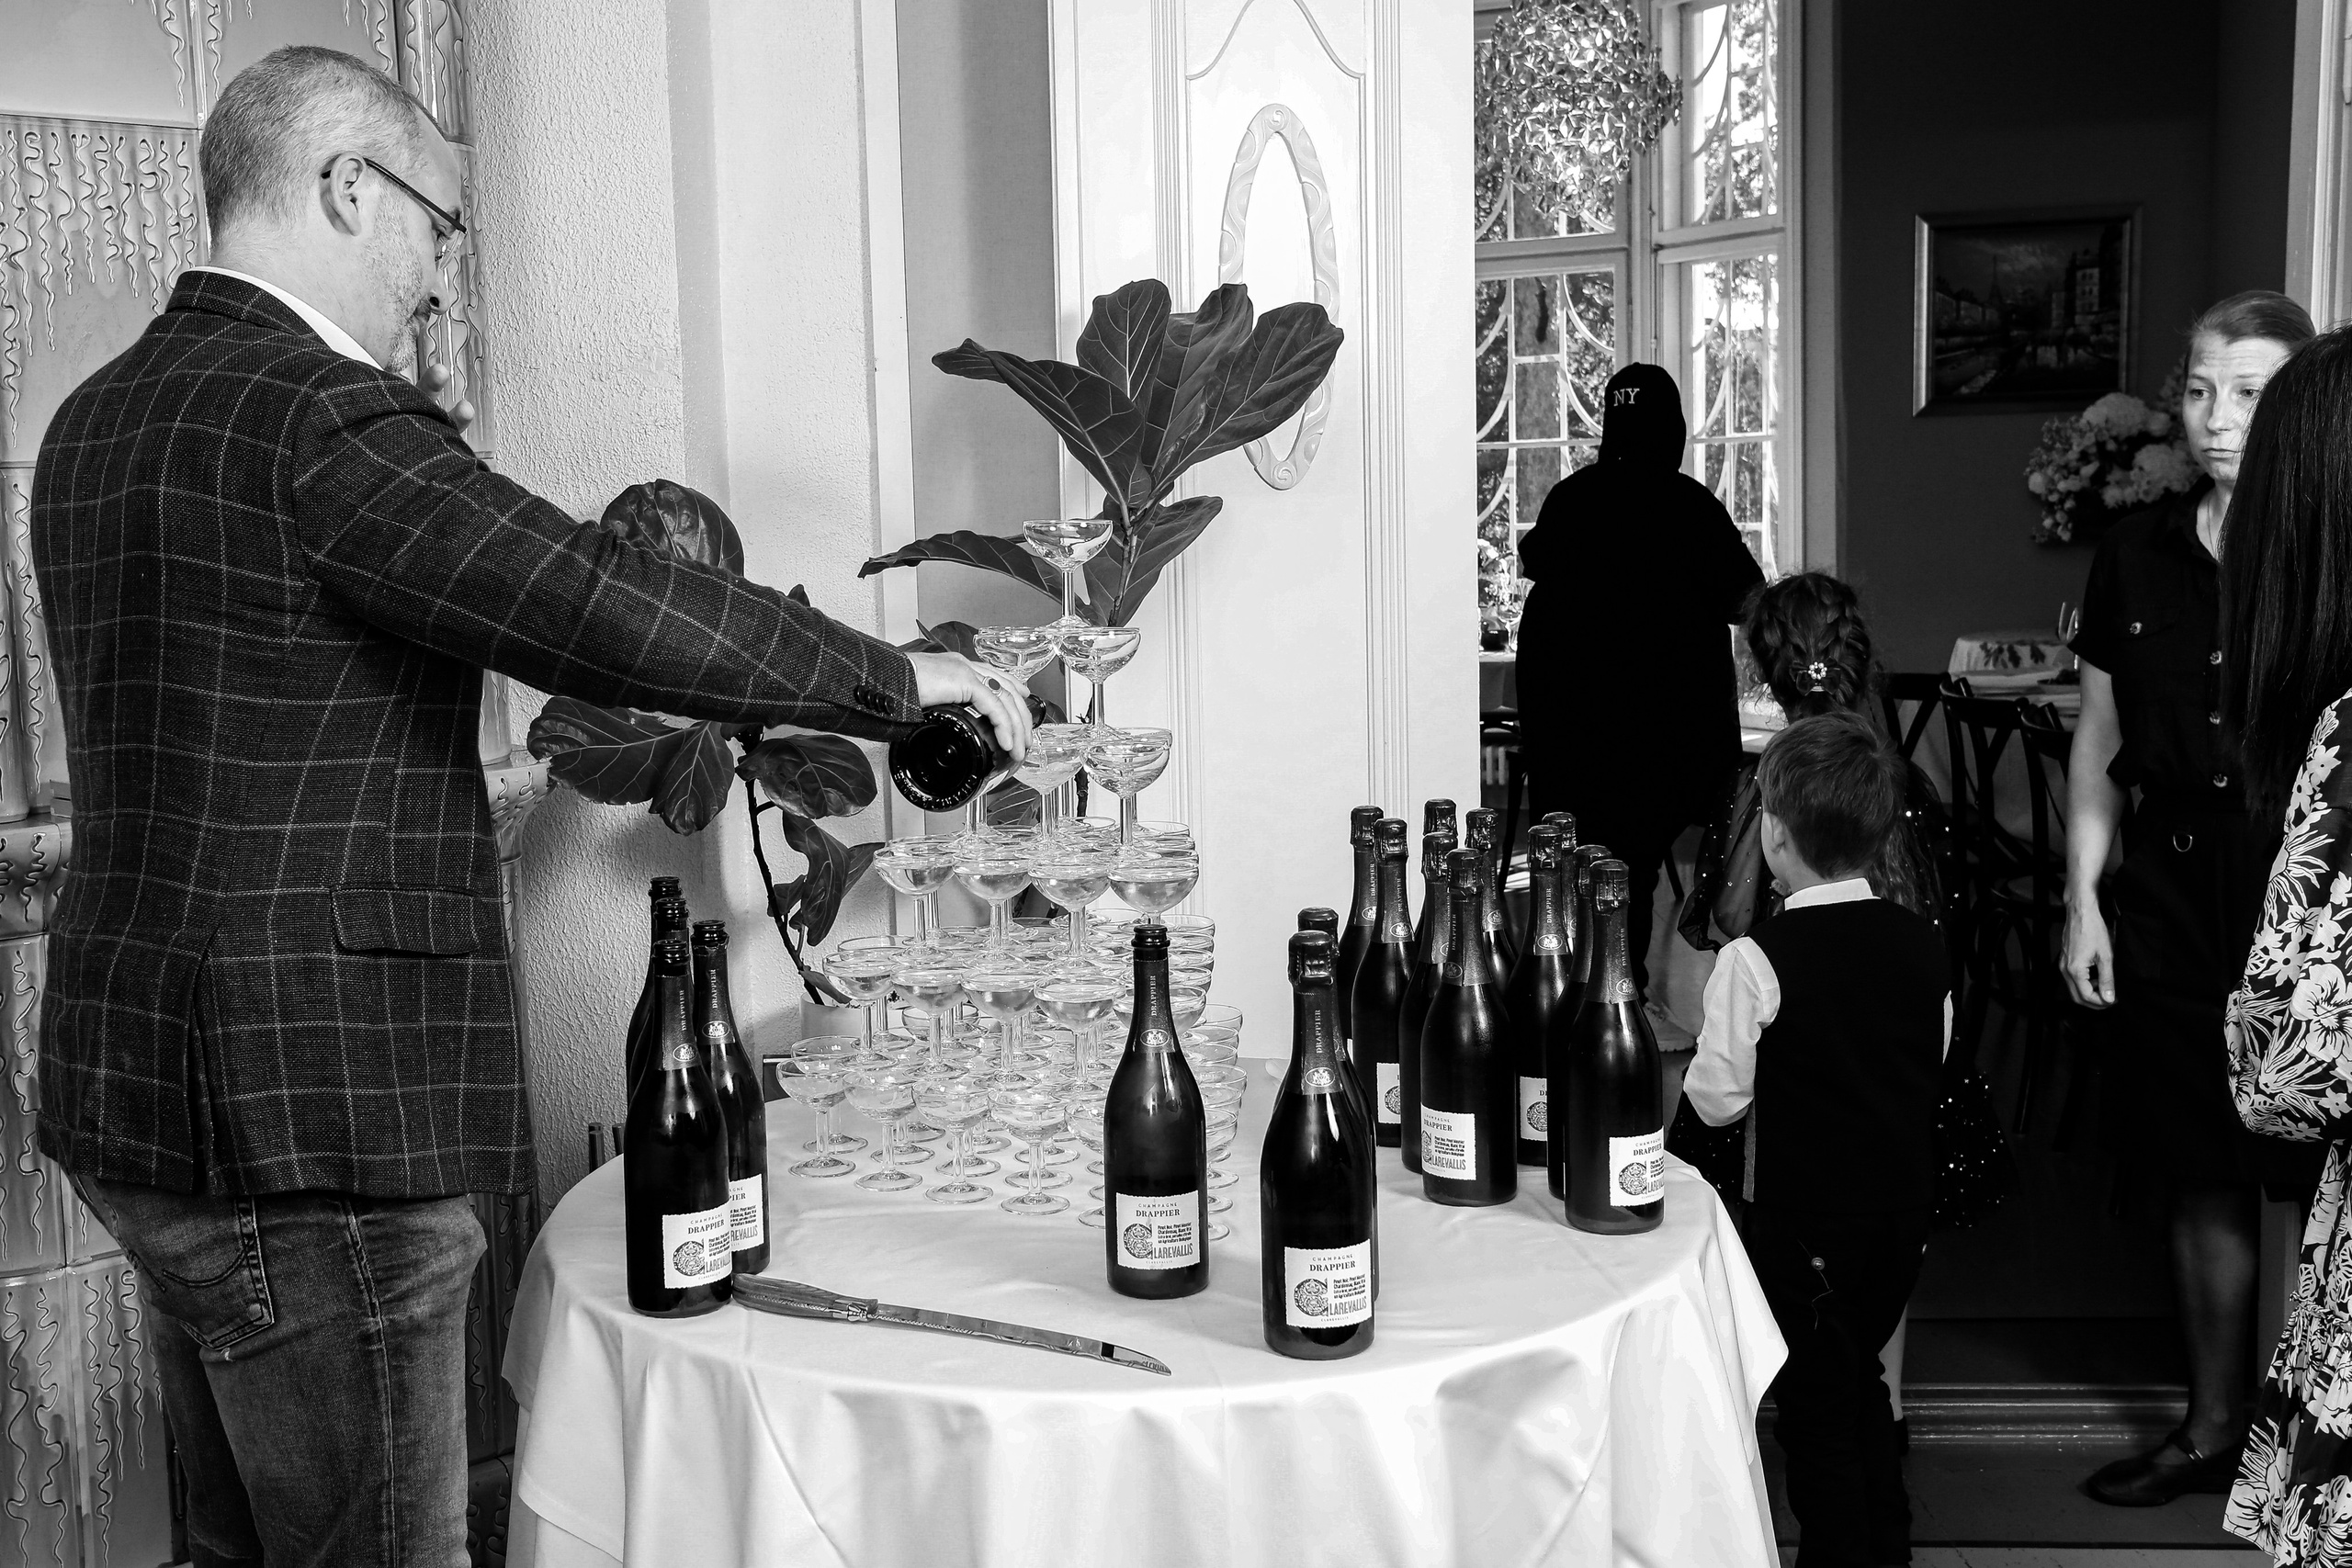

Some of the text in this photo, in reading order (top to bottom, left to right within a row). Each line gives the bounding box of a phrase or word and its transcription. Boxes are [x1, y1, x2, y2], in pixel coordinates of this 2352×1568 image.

[1613, 388, 1640, 407] NY
[709, 969, 718, 1009] DRAPPIER
[679, 989, 687, 1032] DRAPPIER
[1314, 1009, 1323, 1054] DRAPPIER
[1423, 1118, 1453, 1132] DRAPPIER
[1633, 1143, 1662, 1156] DRAPPIER
[690, 1213, 723, 1224] CHAMPAGNE
[1136, 1209, 1181, 1217] DRAPPIER
[687, 1219, 725, 1235] DRAPPIER
[1312, 1254, 1353, 1262] CHAMPAGNE
[1309, 1260, 1356, 1272] DRAPPIER
